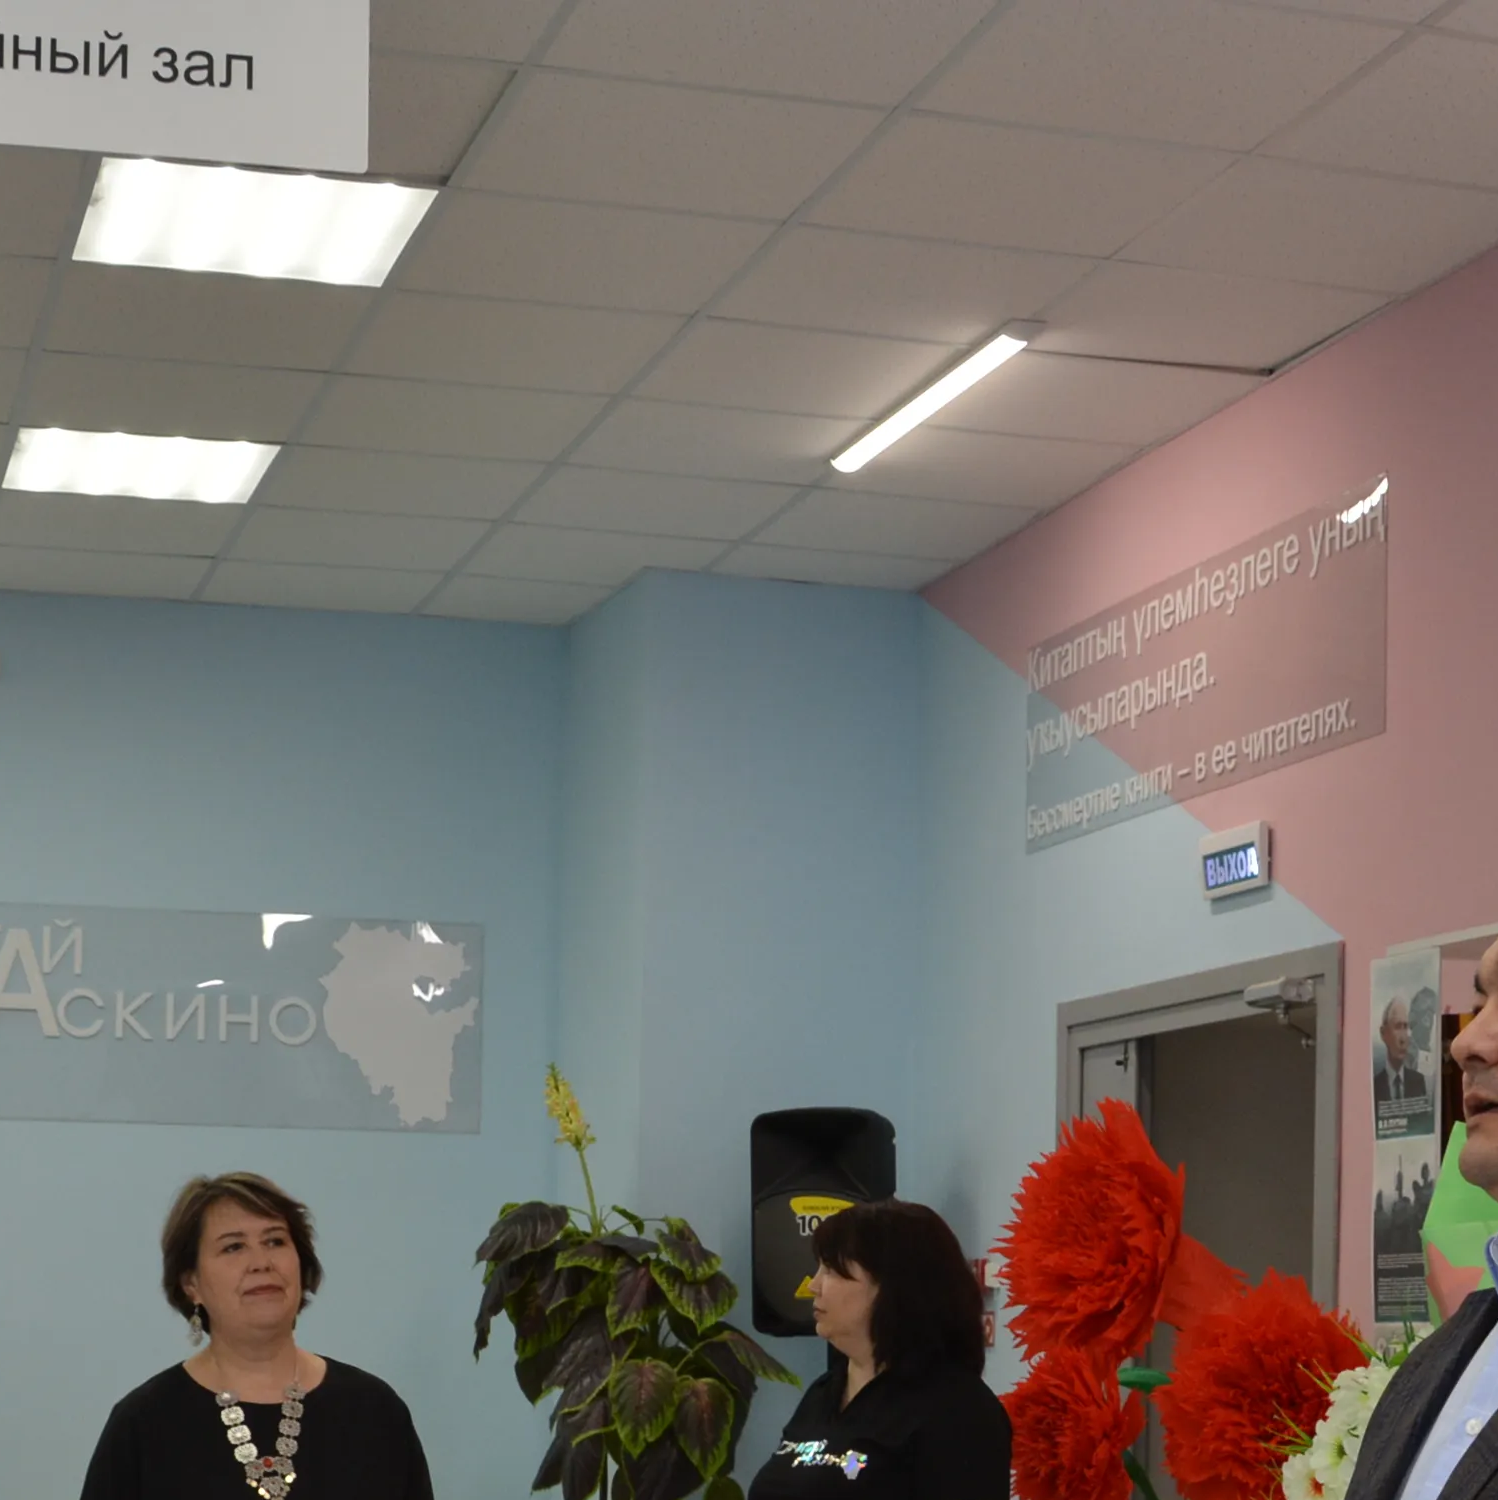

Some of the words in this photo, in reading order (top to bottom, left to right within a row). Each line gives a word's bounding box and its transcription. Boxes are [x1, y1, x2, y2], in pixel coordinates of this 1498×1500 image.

[152, 40, 255, 91] зал
[1027, 781, 1122, 842] Бессмертие
[1124, 761, 1174, 810] книги
[1194, 751, 1208, 783] в
[1211, 739, 1238, 776] ее
[1241, 698, 1357, 765] читателях.
[1205, 845, 1260, 889] ВЫХОД
